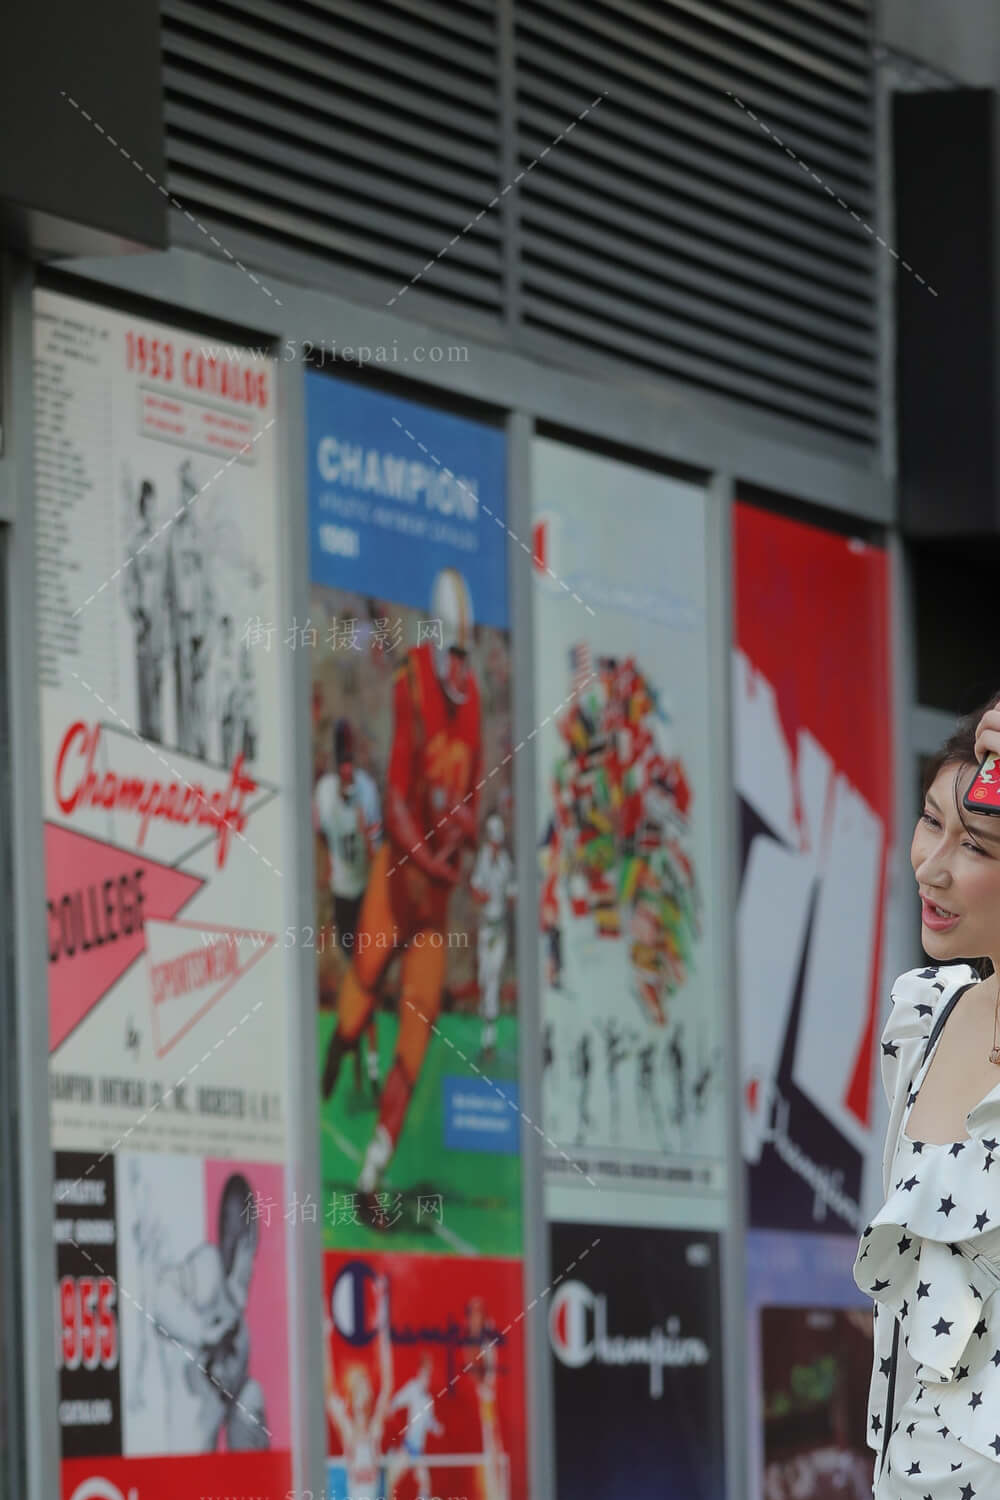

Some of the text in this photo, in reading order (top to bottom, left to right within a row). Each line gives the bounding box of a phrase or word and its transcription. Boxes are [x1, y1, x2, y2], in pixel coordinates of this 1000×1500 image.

[183, 348, 267, 409] CATALOG
[317, 435, 479, 521] CHAMPION
[47, 868, 146, 963] COLLEGE
[55, 1275, 118, 1370] 955
[548, 1280, 709, 1399] Champion
